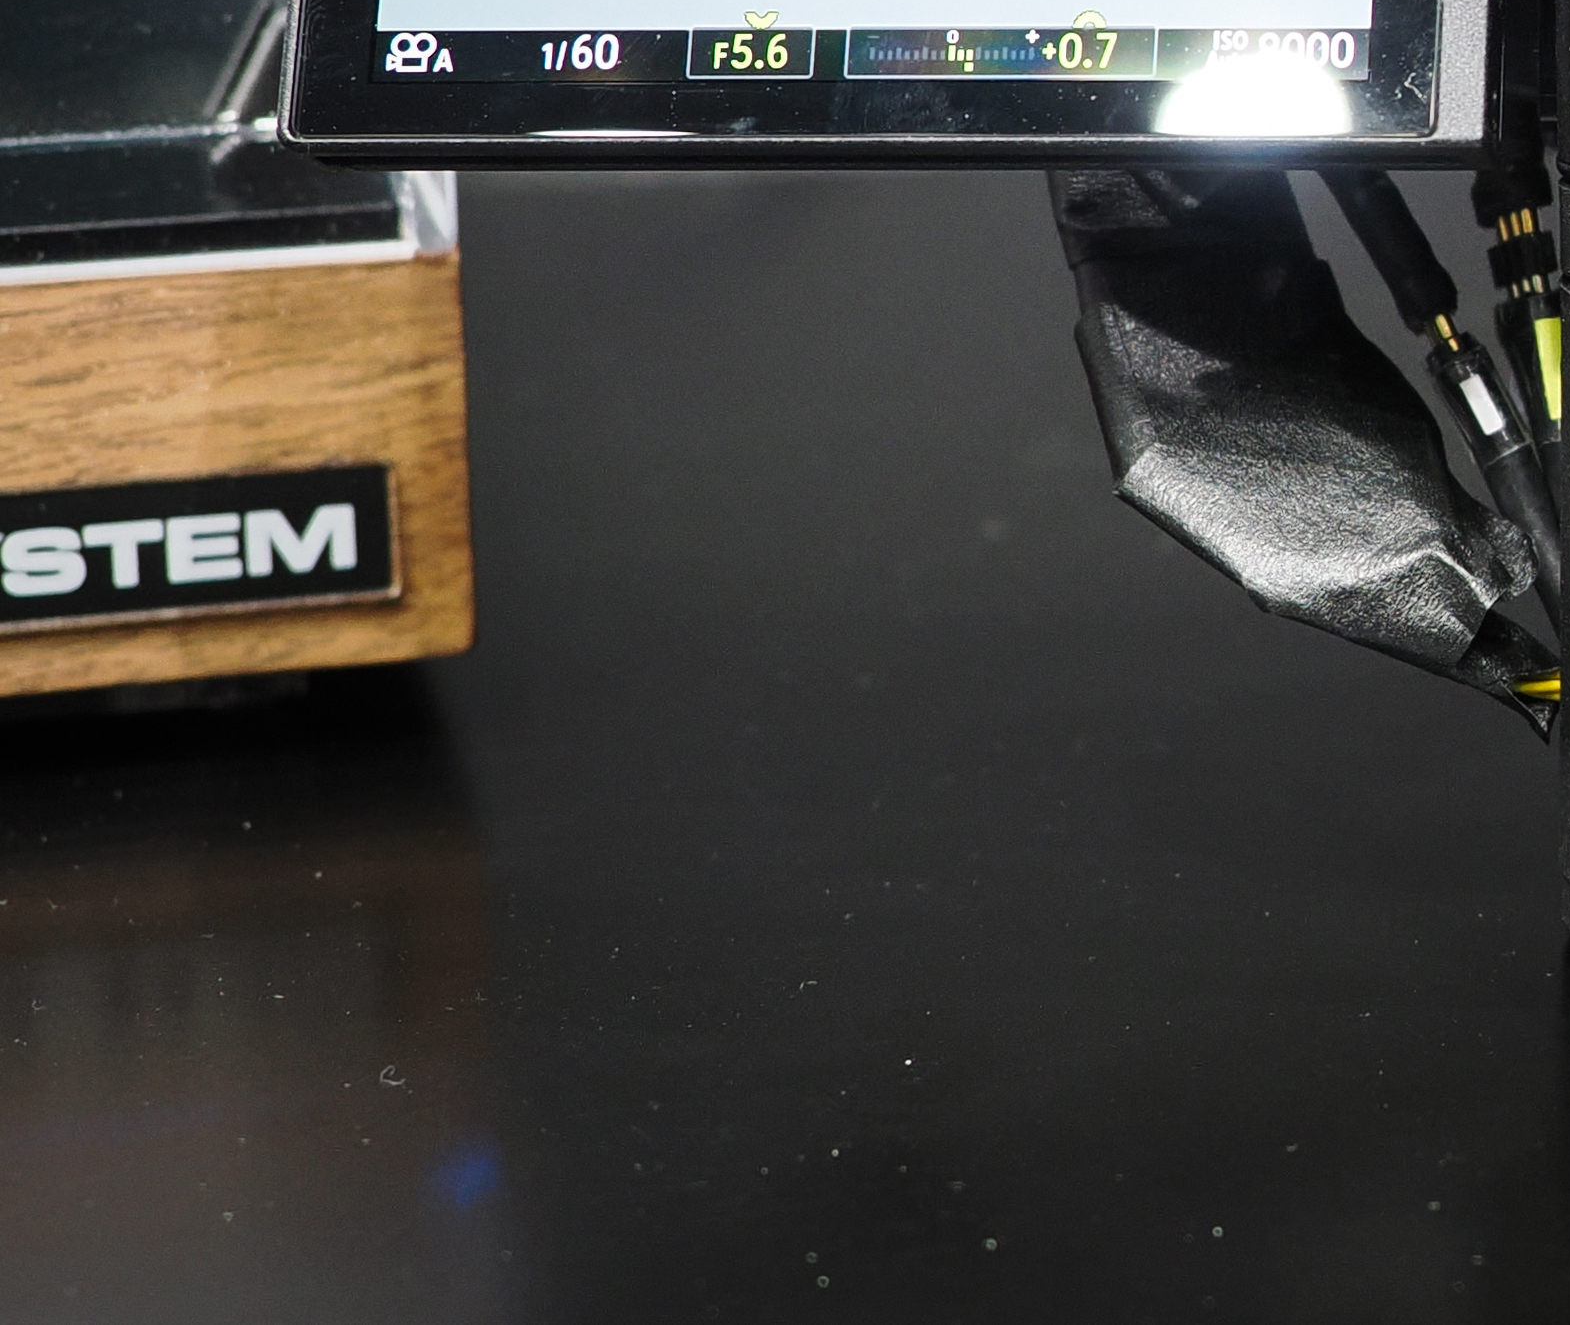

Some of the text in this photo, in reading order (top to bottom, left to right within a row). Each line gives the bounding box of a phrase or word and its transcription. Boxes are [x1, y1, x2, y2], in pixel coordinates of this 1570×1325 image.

[541, 32, 620, 71] 1/60
[712, 32, 789, 71] F5.6
[1041, 31, 1119, 70] +0.7
[1212, 29, 1250, 52] ISO
[0, 502, 358, 599] STEM
